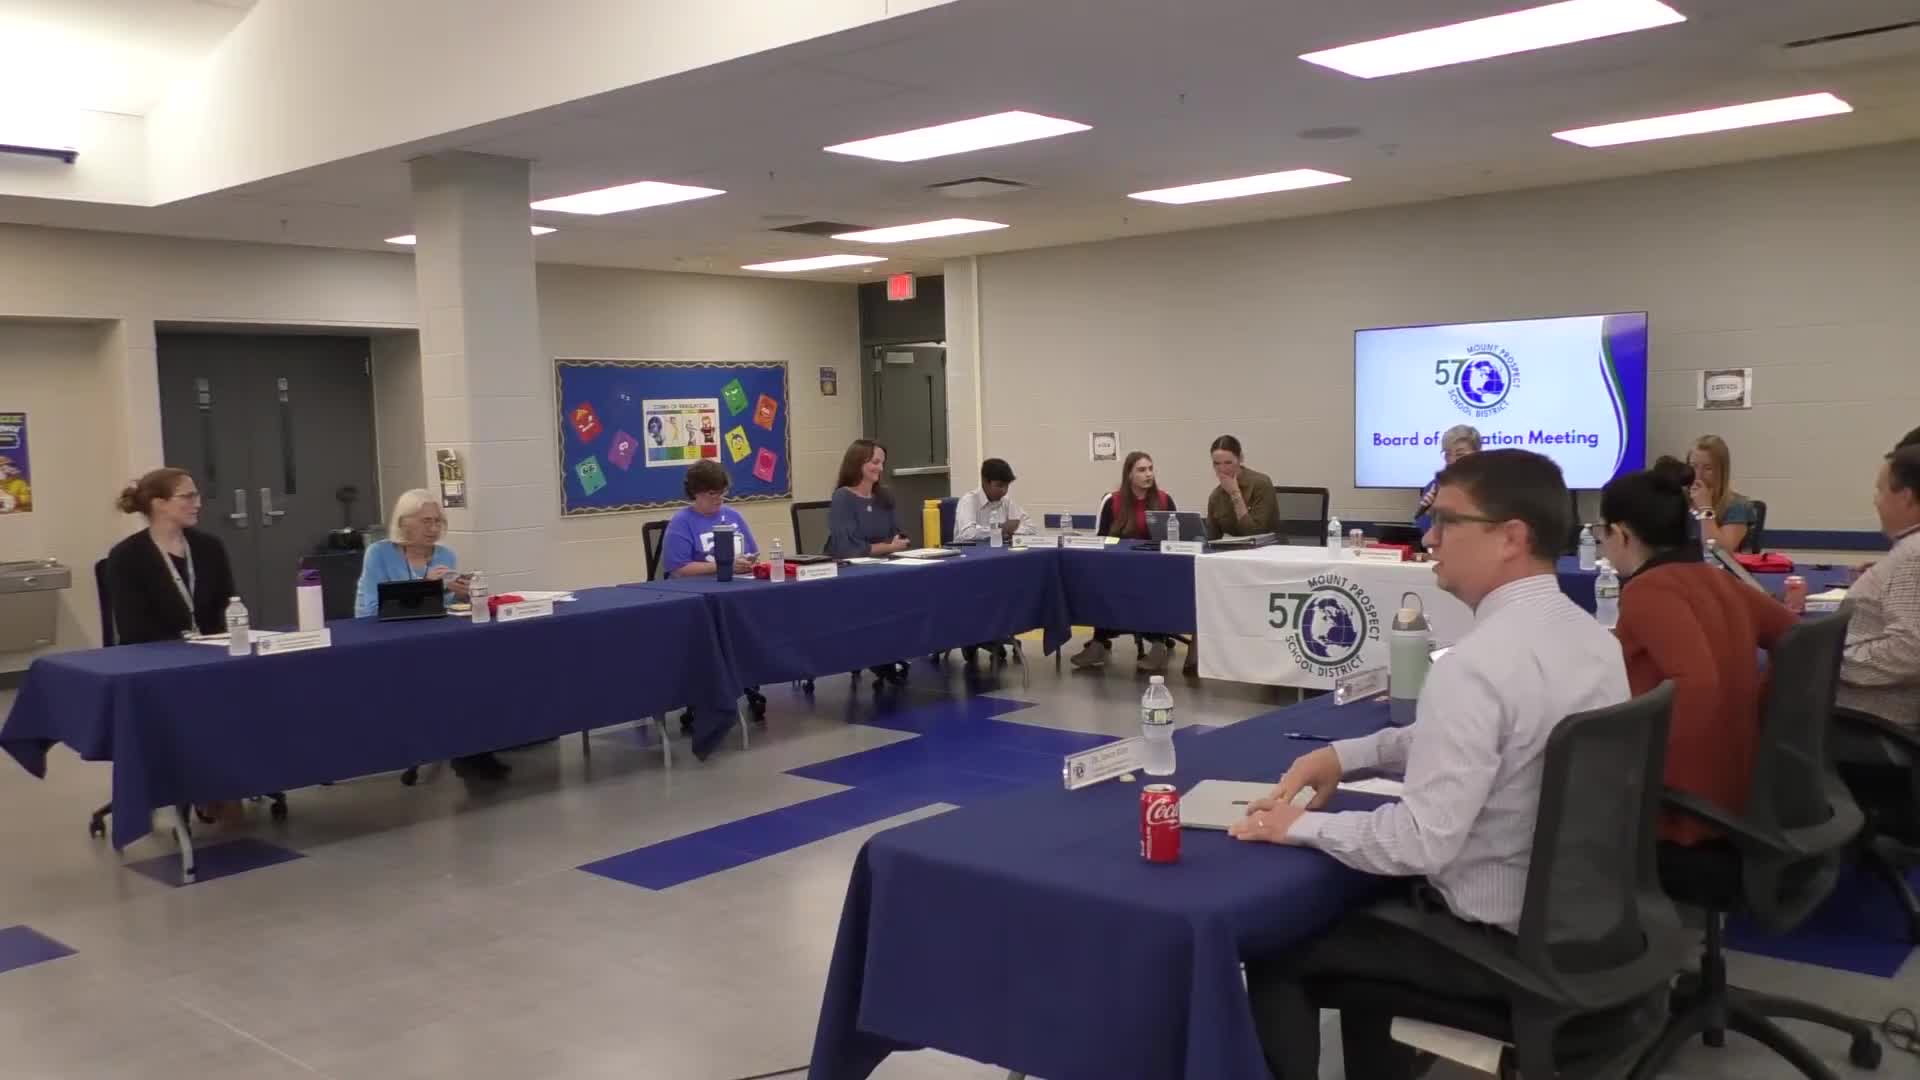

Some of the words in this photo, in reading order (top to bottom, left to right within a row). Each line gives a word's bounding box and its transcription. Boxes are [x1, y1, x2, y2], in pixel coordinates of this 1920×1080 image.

[1435, 359, 1470, 386] 57
[1466, 343, 1499, 353] MOUNT
[1500, 348, 1521, 388] PROSPECT
[1447, 388, 1472, 416] SCHOOL
[1475, 400, 1509, 418] DISTRICT
[1373, 432, 1419, 446] Board
[1423, 431, 1440, 446] of
[1480, 430, 1523, 445] ation
[1528, 429, 1598, 448] Meeting
[1269, 592, 1313, 630] 57
[1307, 574, 1348, 588] MOUNT
[1349, 583, 1380, 641] PROSPECT
[1285, 635, 1314, 673] SCHOOL
[1318, 655, 1364, 678] DISTRICT
